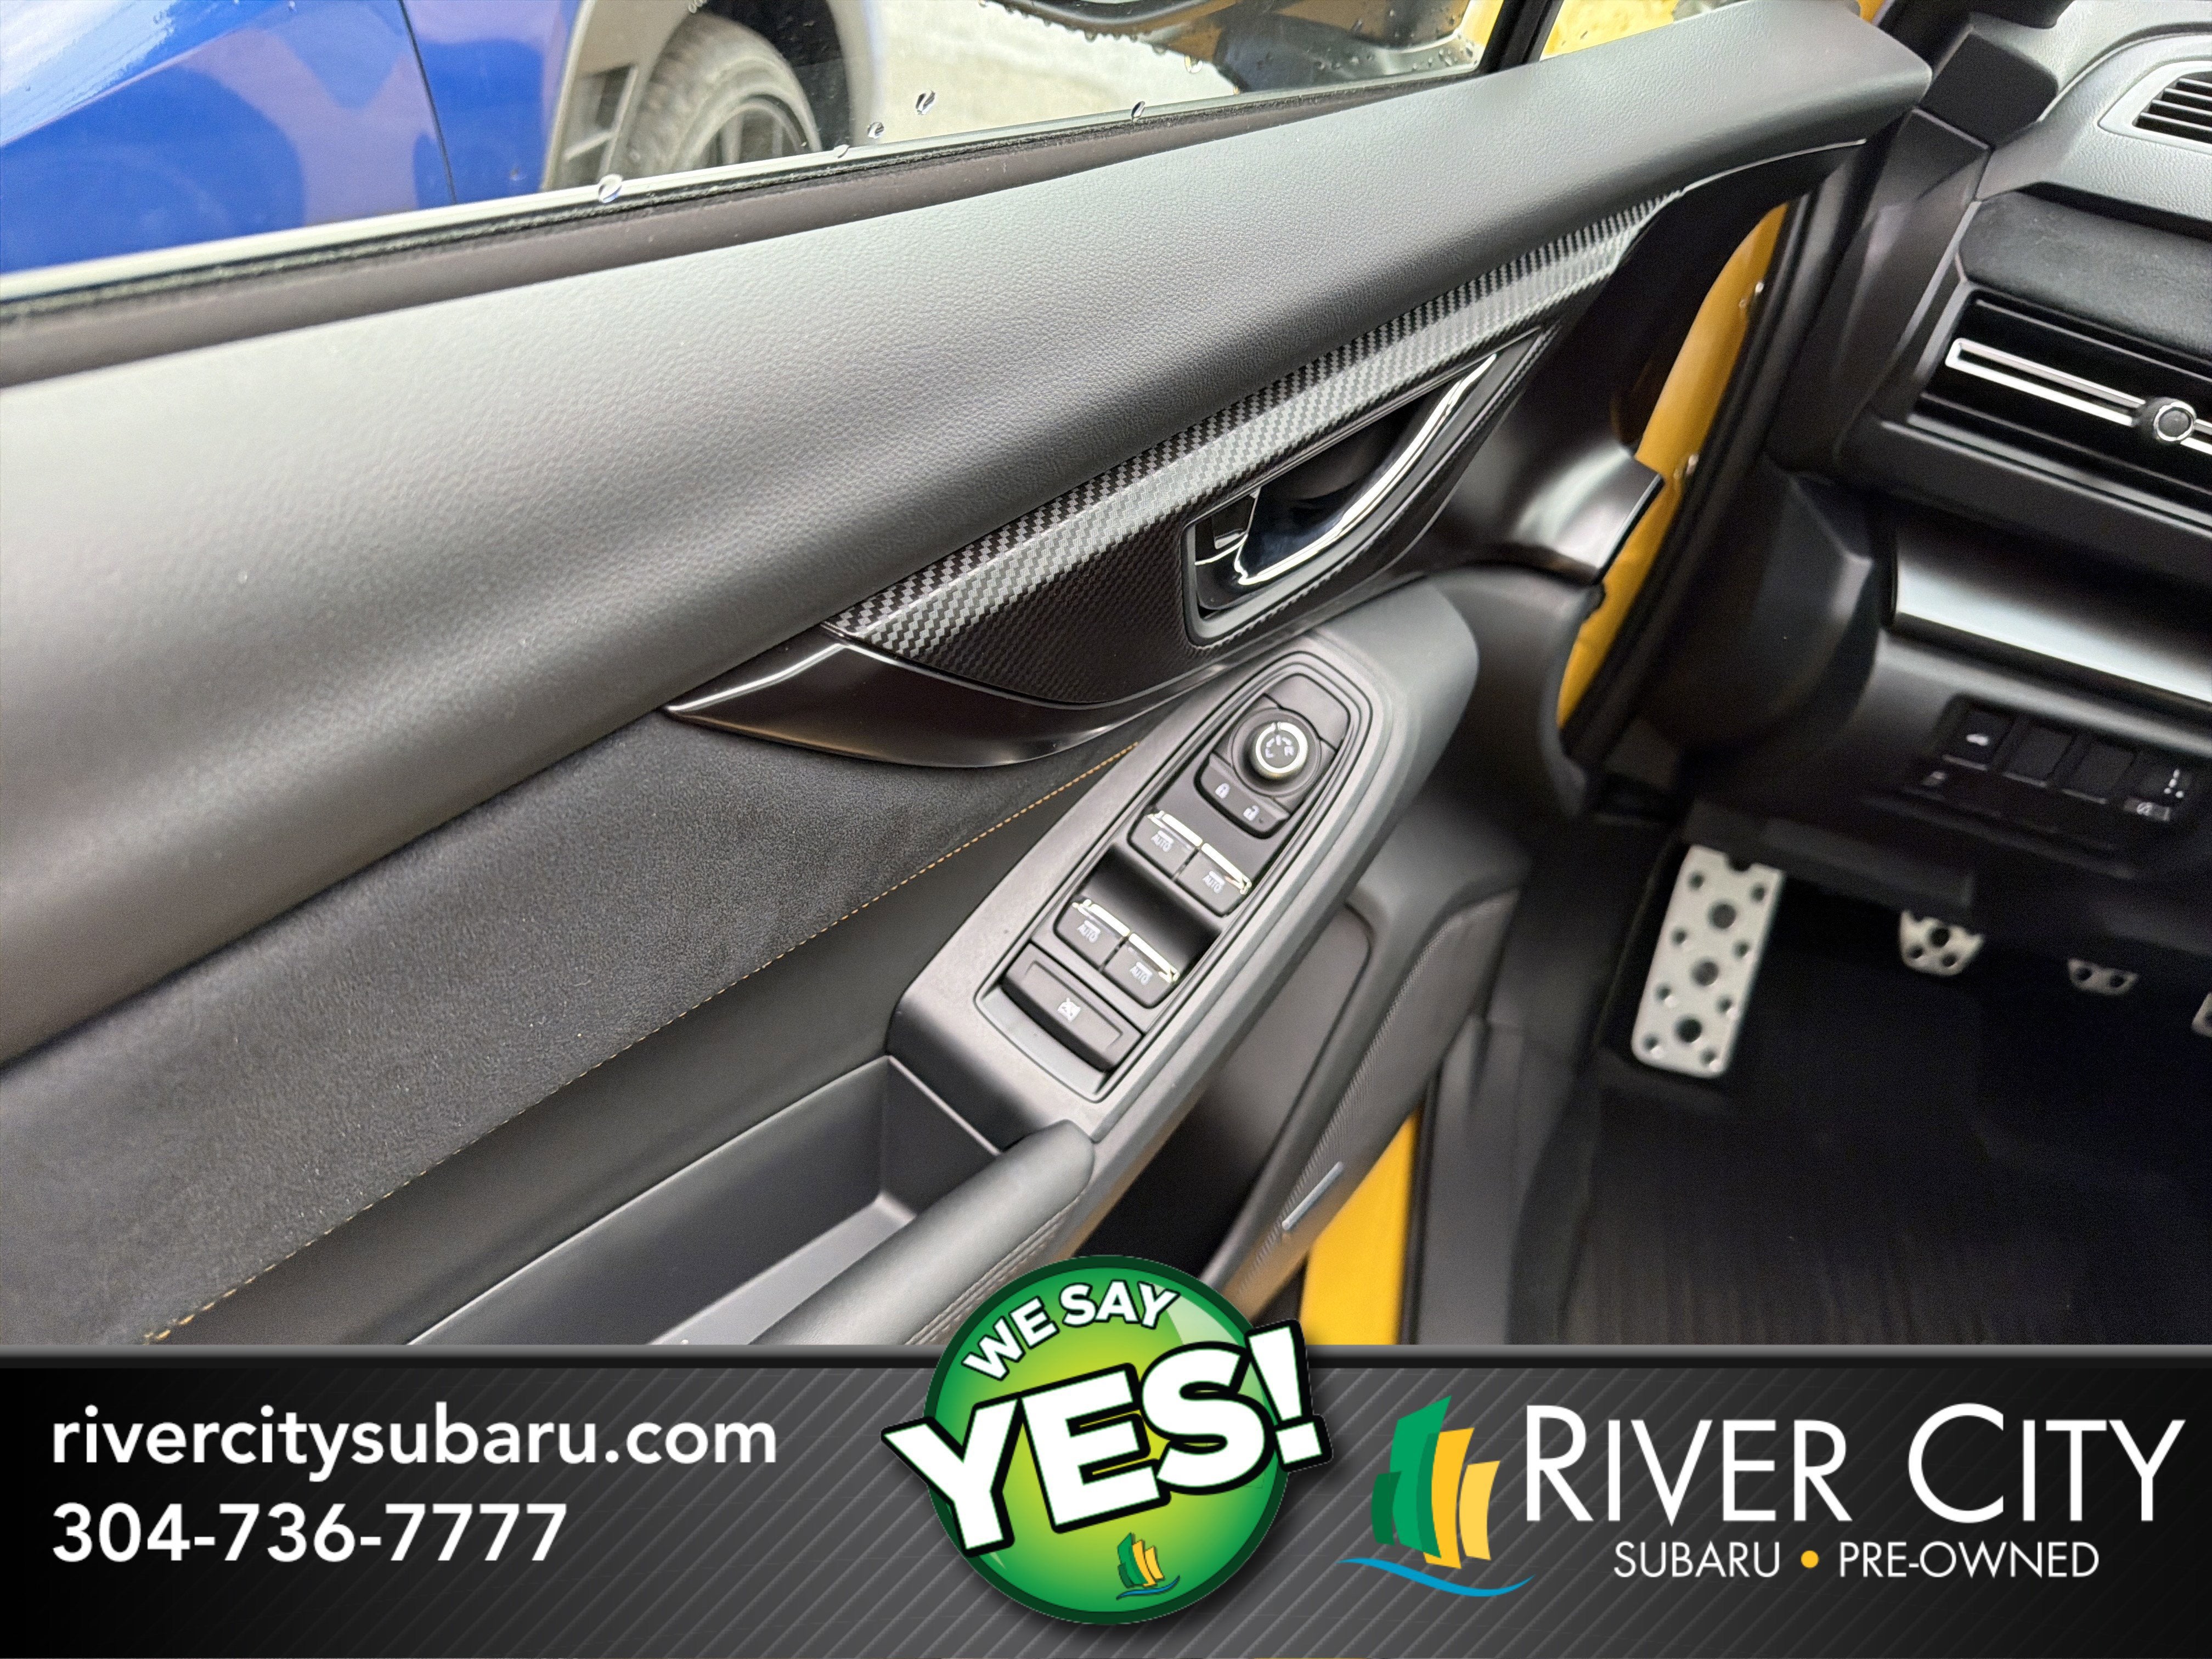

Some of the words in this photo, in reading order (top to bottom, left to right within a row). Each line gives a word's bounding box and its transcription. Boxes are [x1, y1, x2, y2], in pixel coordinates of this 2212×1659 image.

[1150, 833, 1172, 853] AUTO
[1201, 874, 1223, 894] AUTO
[1077, 923, 1098, 943] AUTO
[1129, 965, 1150, 986] AUTO
